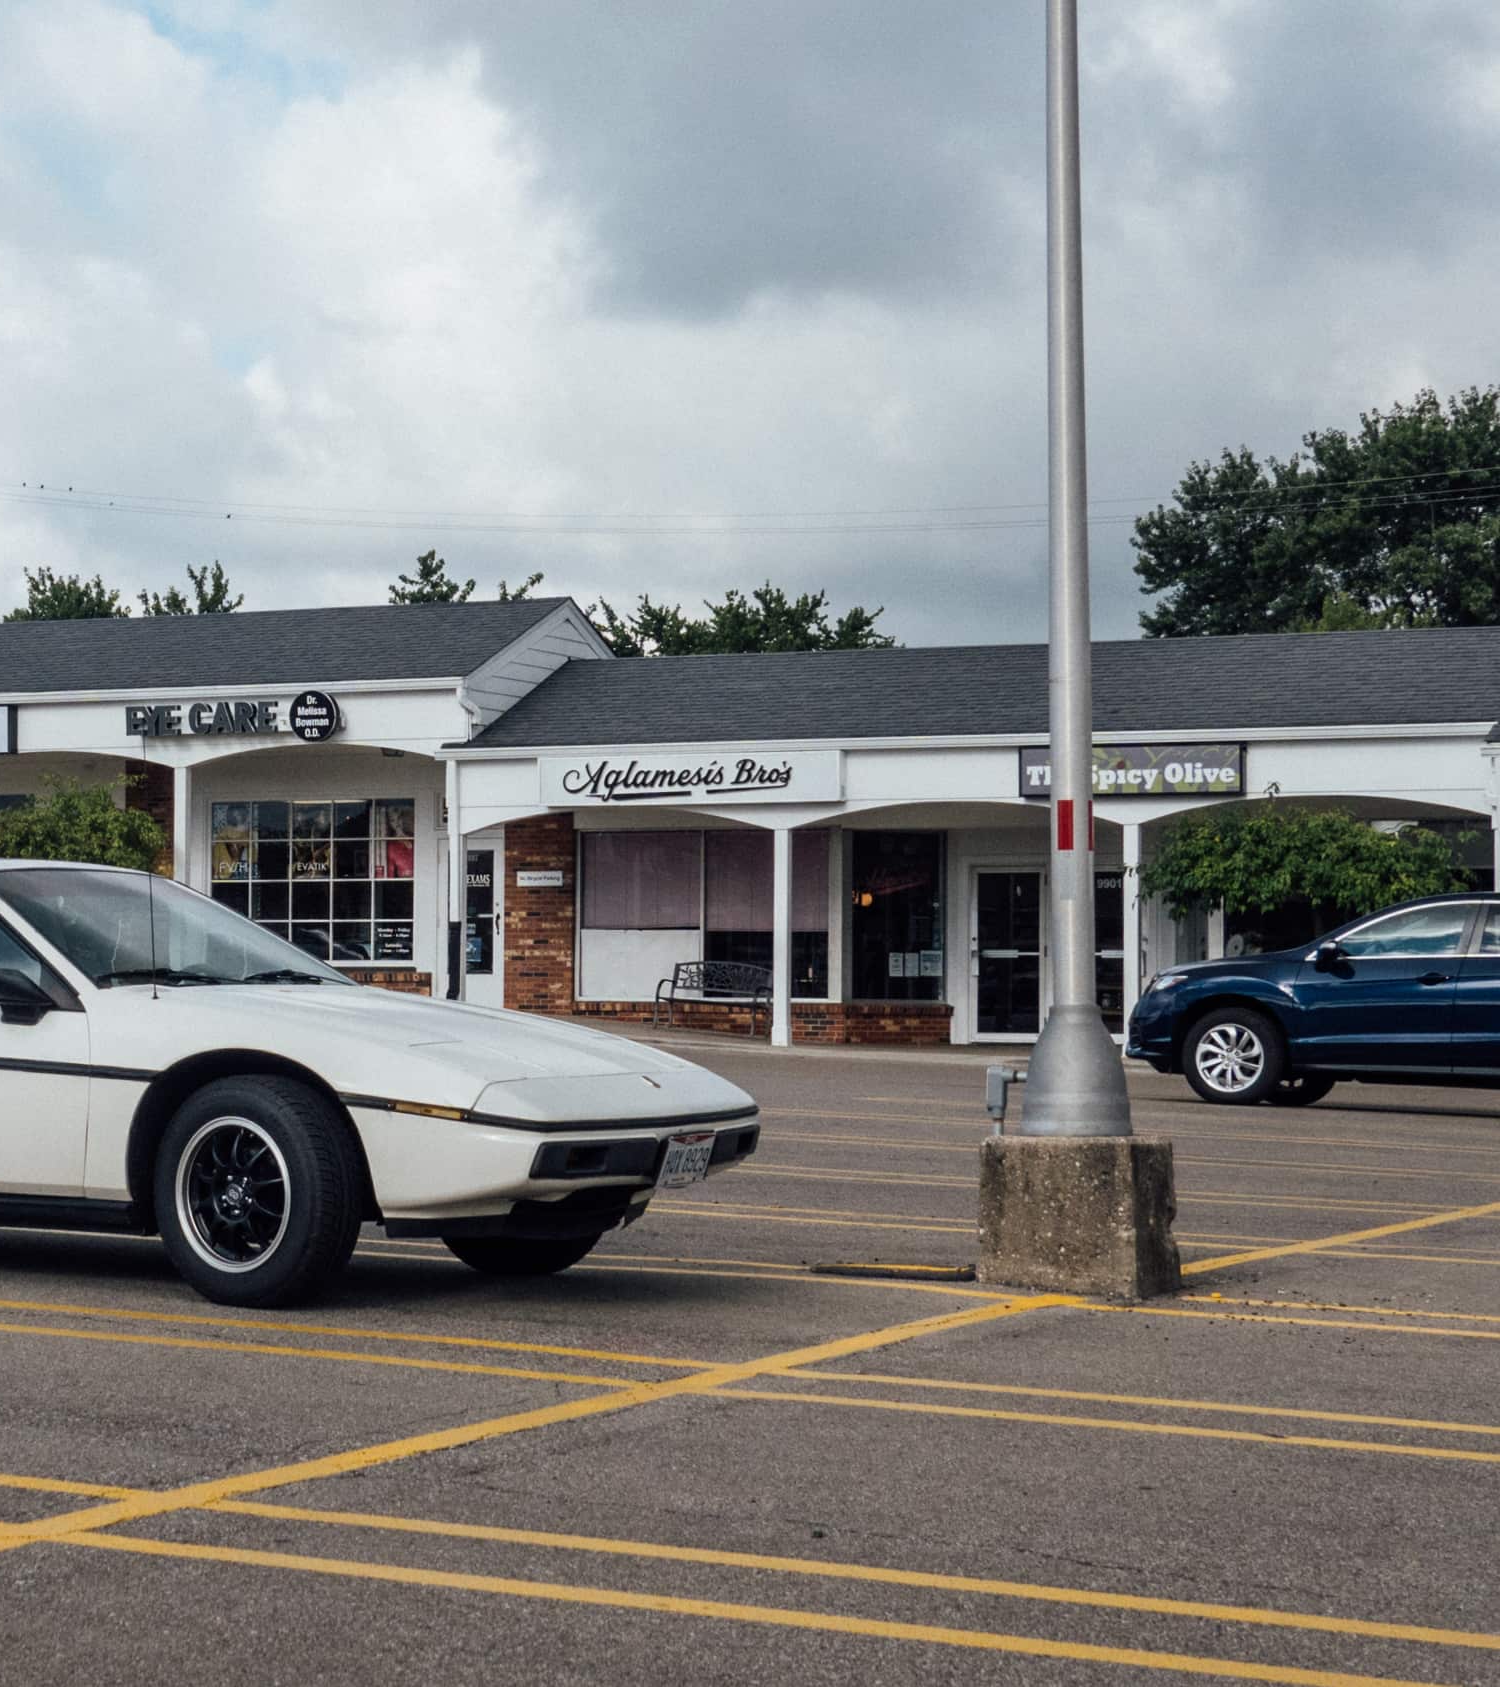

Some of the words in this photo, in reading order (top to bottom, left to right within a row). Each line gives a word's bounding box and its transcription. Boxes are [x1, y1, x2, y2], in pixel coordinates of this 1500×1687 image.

[306, 695, 318, 705] Dr.
[297, 706, 327, 716] Melissa
[125, 705, 182, 736] EYE
[188, 701, 278, 735] CARE
[295, 717, 329, 727] Bowman
[304, 728, 321, 737] O.D.
[1164, 763, 1236, 783] Olive
